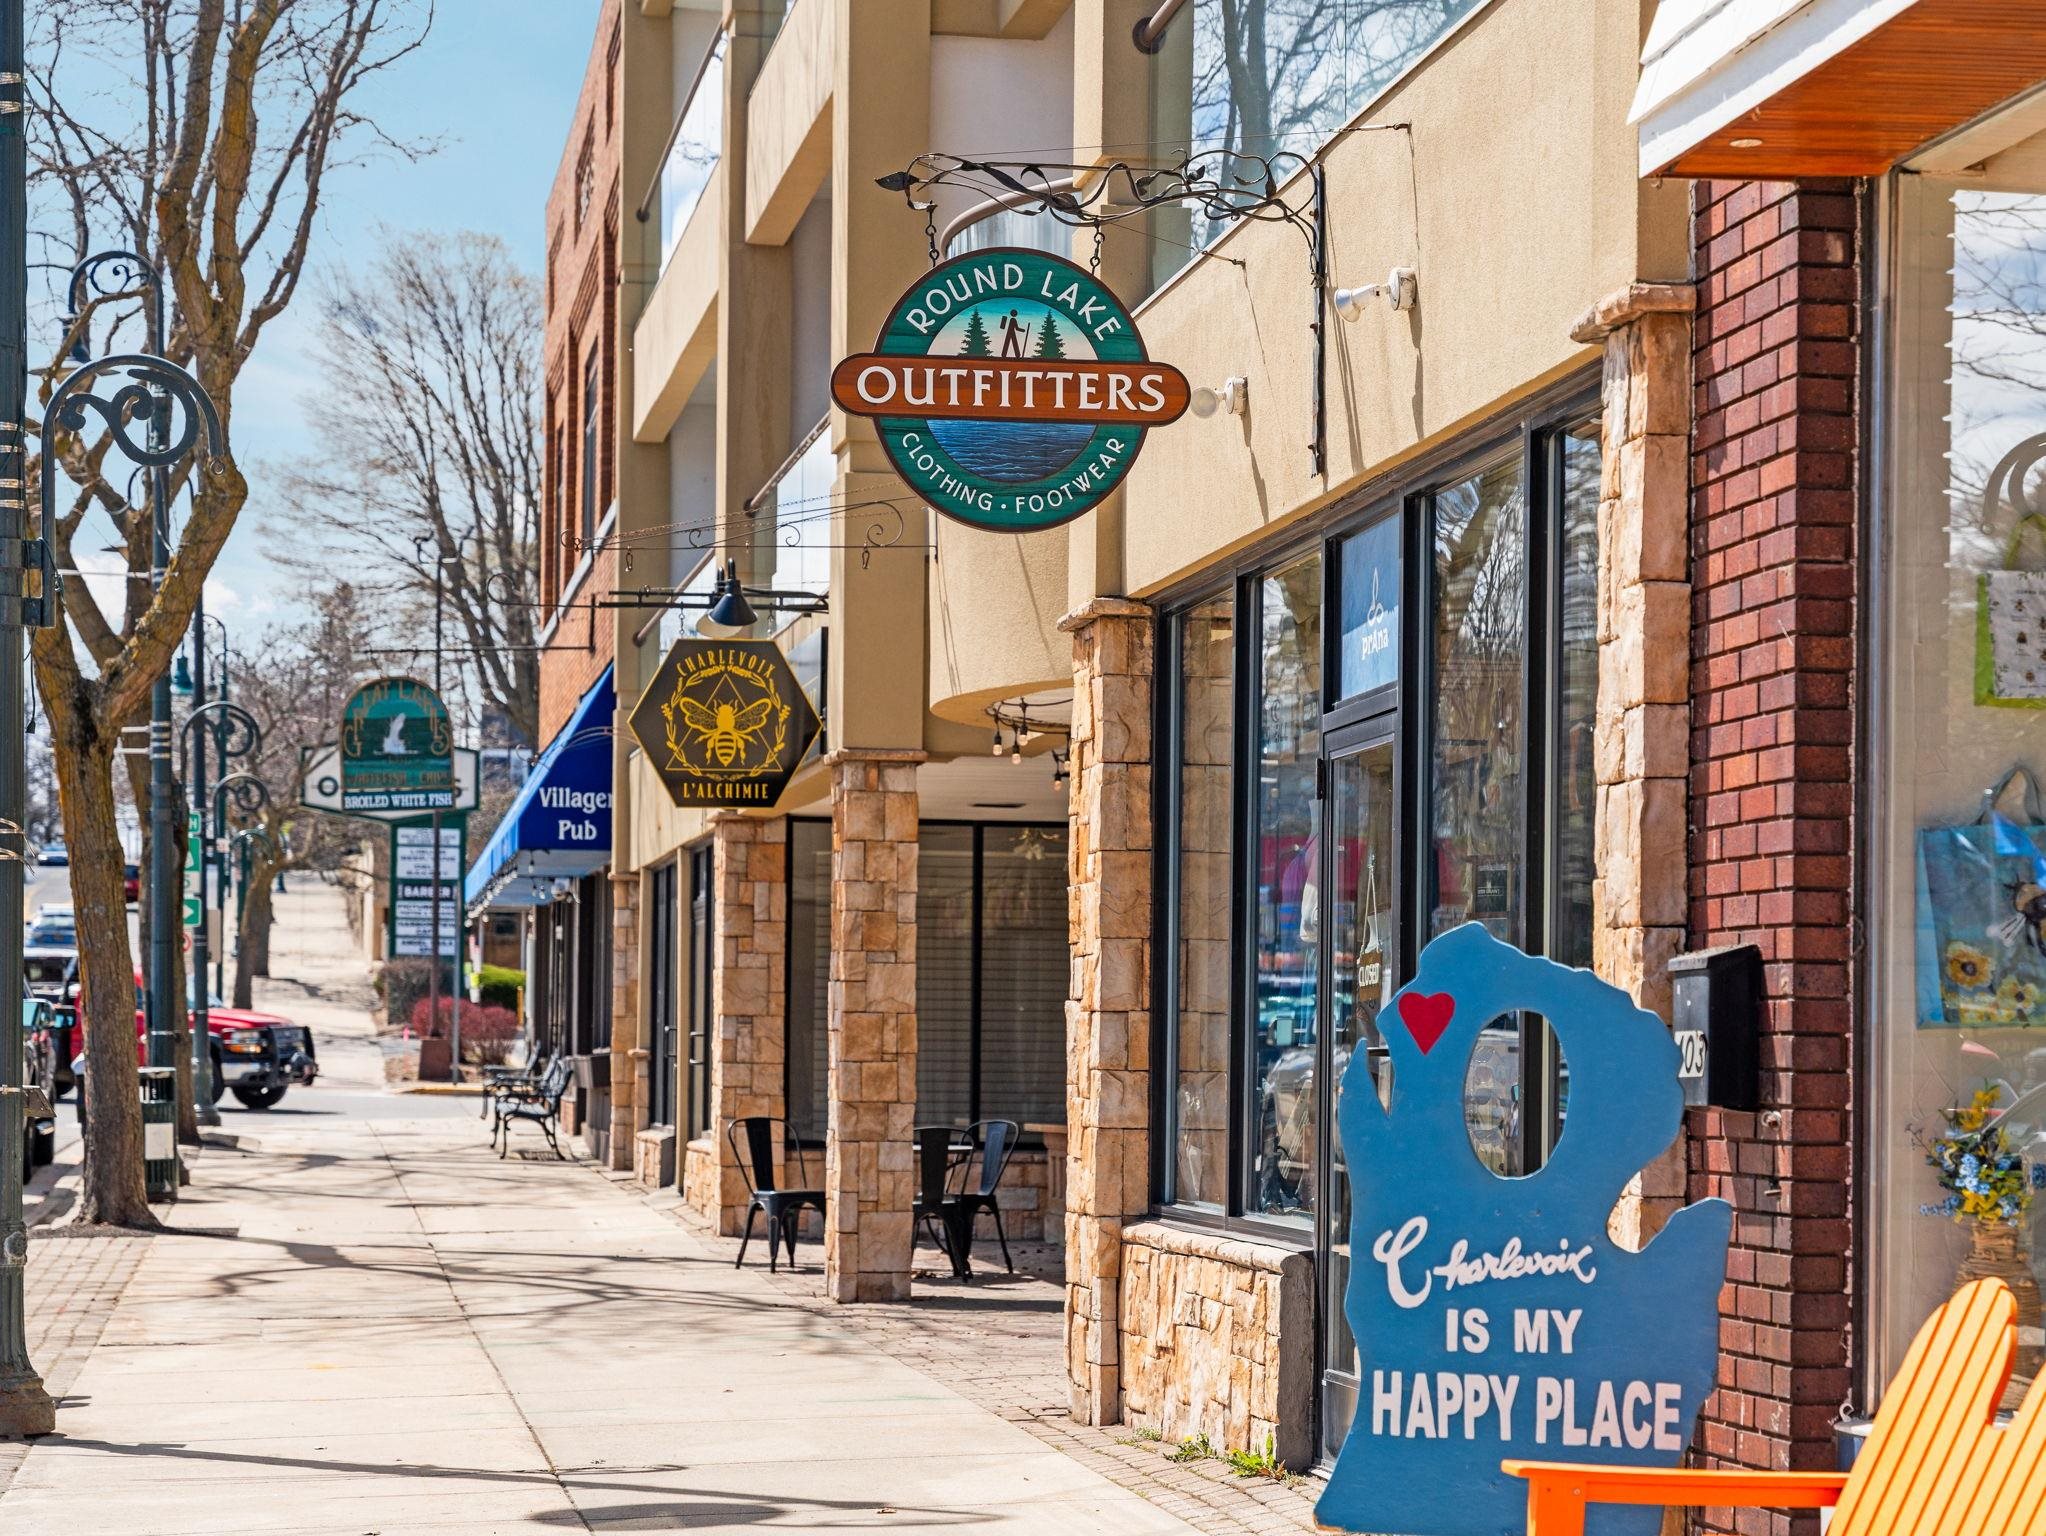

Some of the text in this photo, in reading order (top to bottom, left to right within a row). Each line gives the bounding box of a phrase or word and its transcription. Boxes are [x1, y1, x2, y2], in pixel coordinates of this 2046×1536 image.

[905, 263, 1122, 342] ROUND LAKE
[857, 365, 1166, 412] OUTFITTERS
[902, 432, 1125, 514] CLOTHING FOOTWEAR
[676, 648, 776, 678] CHARLEVOIX
[1361, 628, 1389, 660] prAna
[344, 791, 453, 809] BROILED WHITE FISH
[683, 782, 769, 799] L'ALCHIMIE
[558, 819, 598, 840] Pub
[1372, 1215, 1597, 1310] Charlevoix
[1446, 1308, 1584, 1355] IS MY
[1372, 1370, 1683, 1451] HAPPY PLACE
